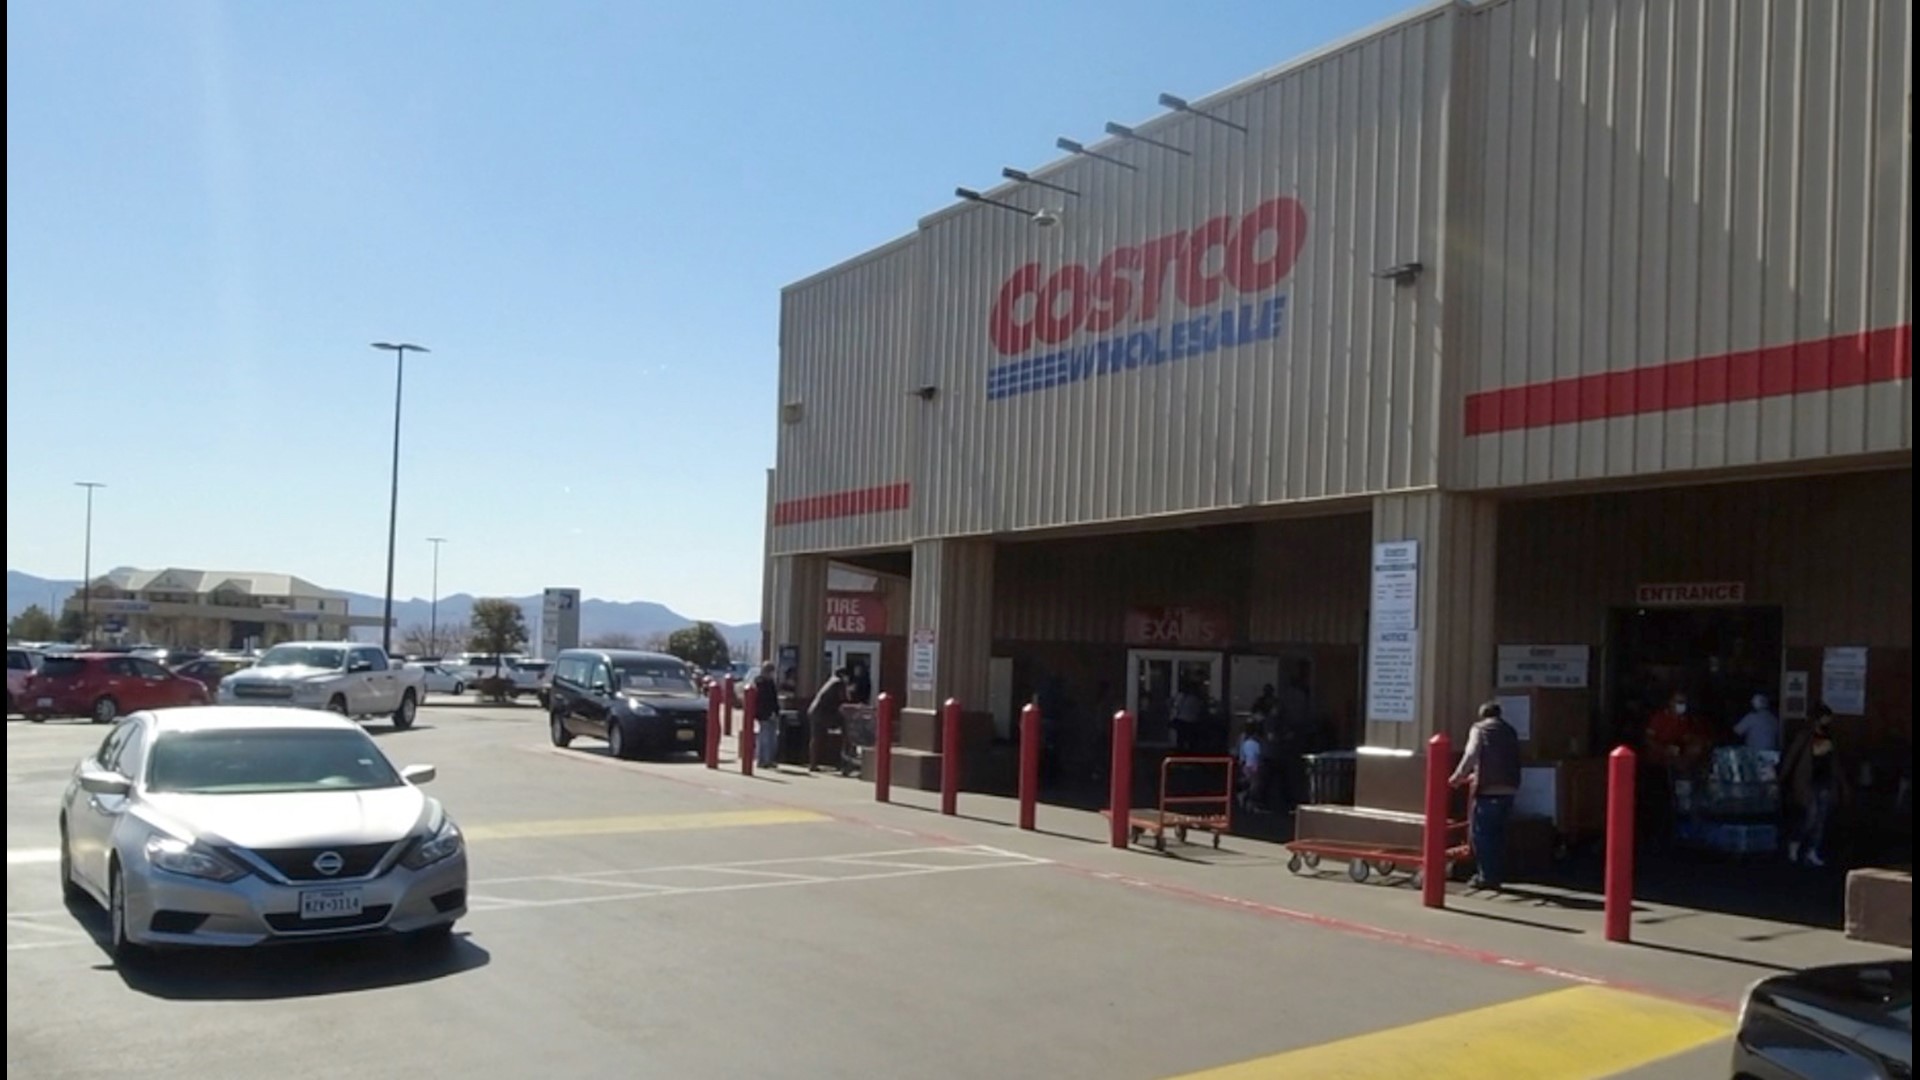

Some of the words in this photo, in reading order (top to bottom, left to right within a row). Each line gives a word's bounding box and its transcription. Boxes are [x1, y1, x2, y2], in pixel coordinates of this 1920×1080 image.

[991, 197, 1308, 356] COSTCO
[1070, 296, 1287, 381] WHOLESALE
[1640, 584, 1741, 602] ENTRANCE
[826, 598, 860, 615] TIRE
[826, 616, 866, 633] ALES
